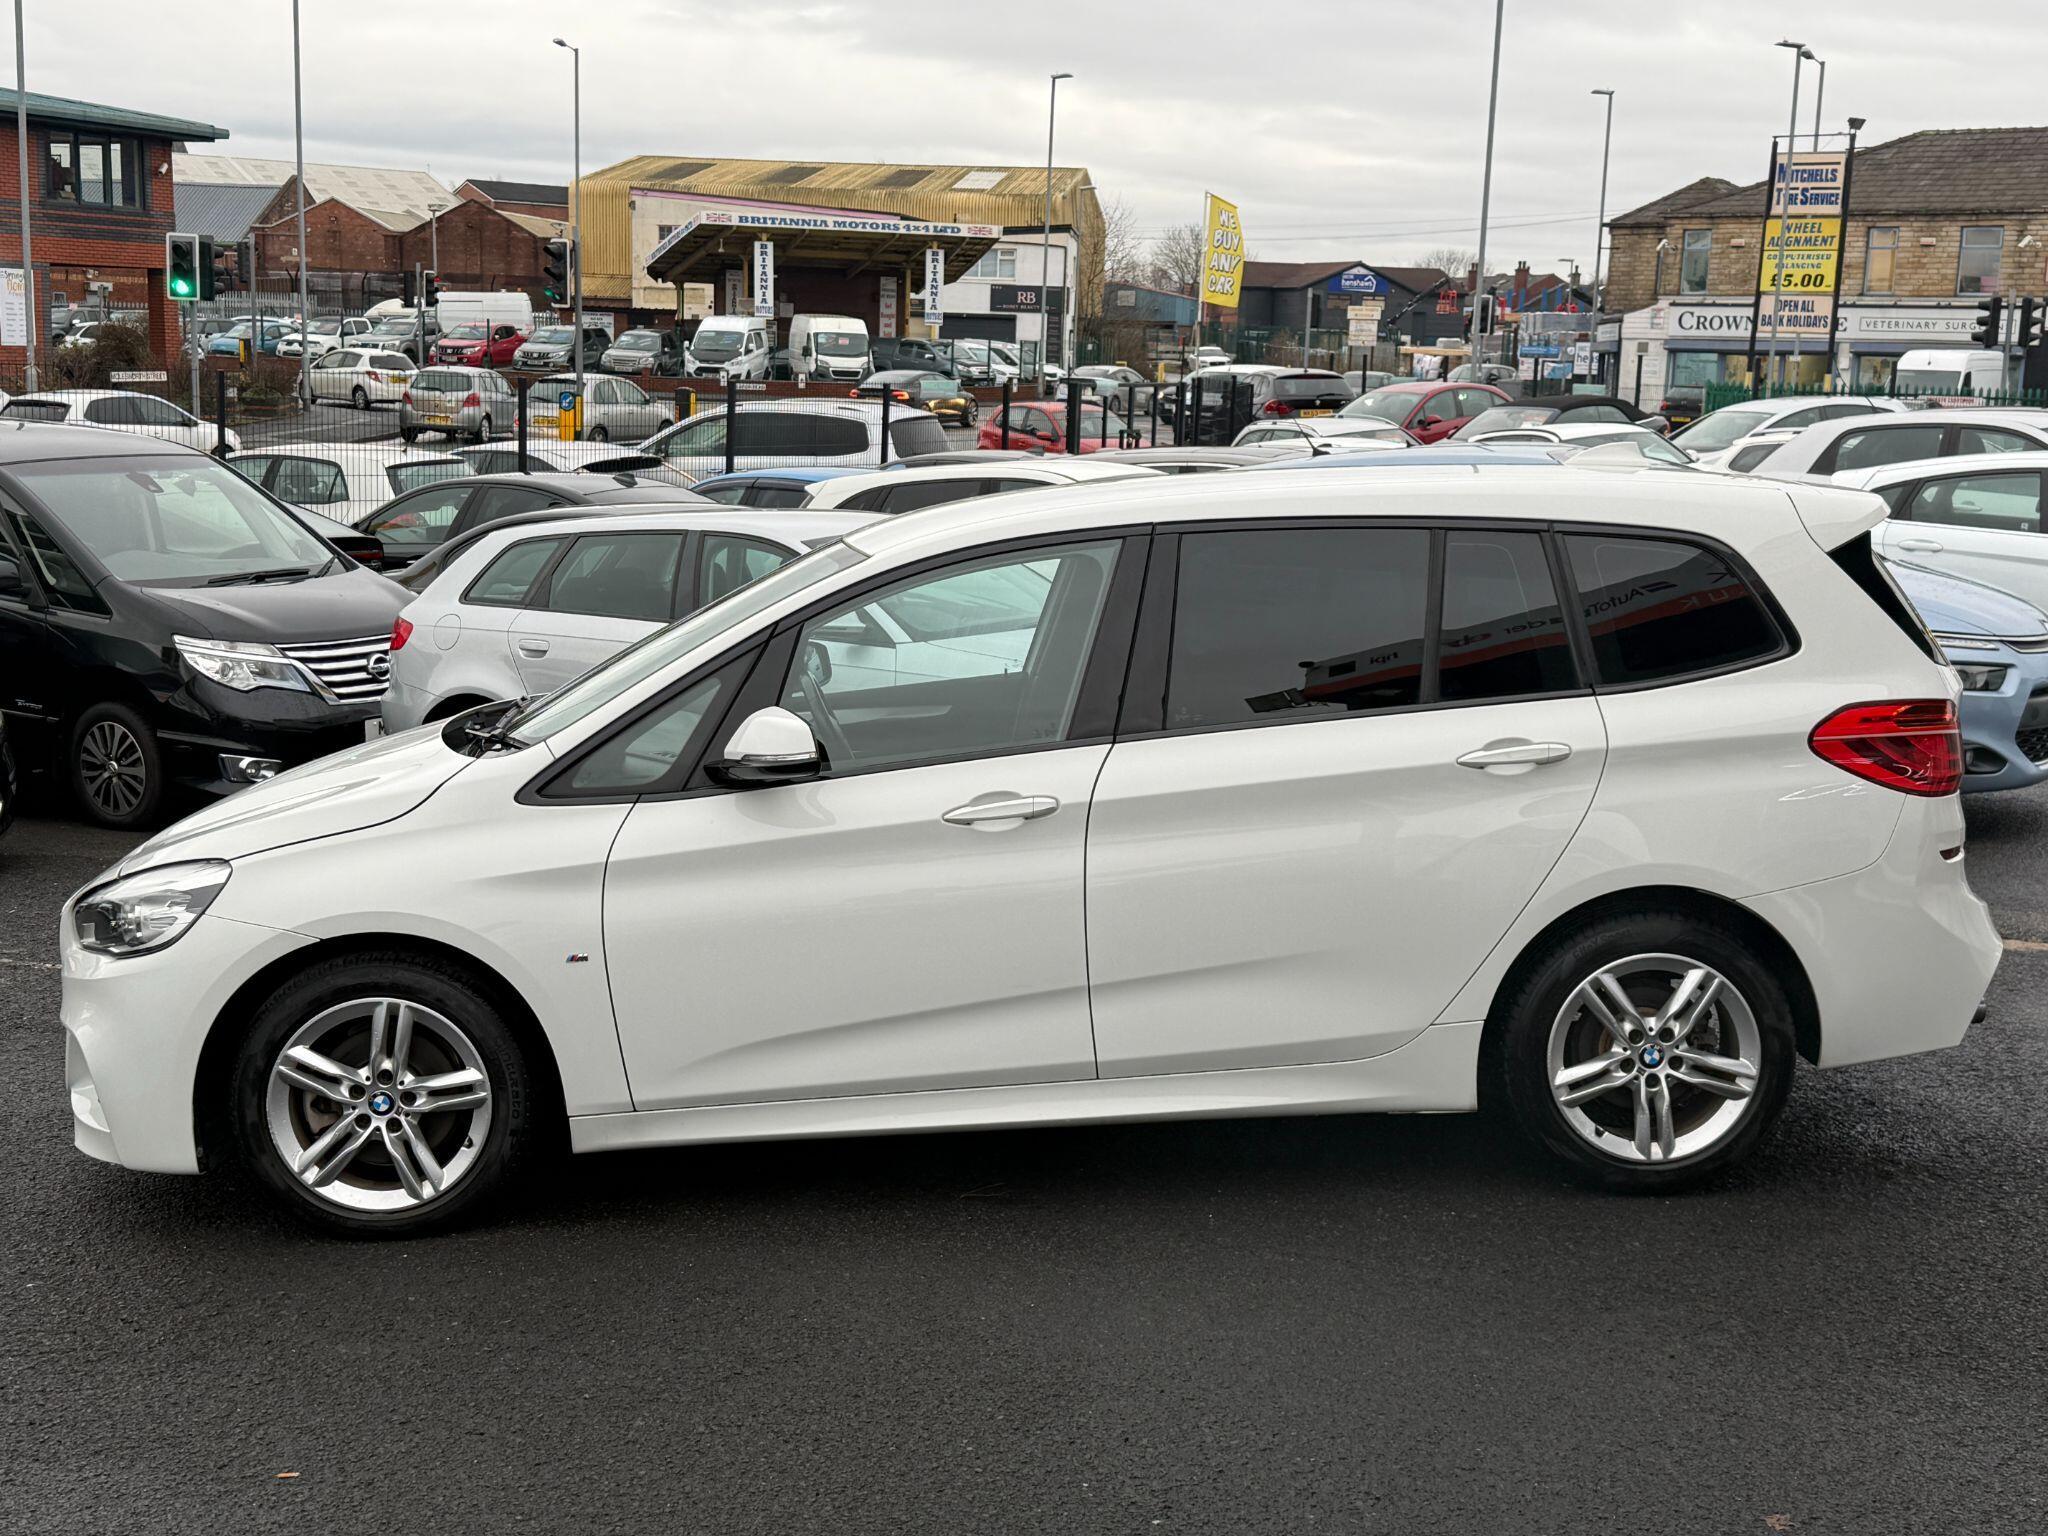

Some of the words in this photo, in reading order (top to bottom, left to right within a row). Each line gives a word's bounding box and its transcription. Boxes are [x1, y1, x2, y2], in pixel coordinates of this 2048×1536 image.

[1800, 187, 1840, 206] SERVICE
[738, 215, 829, 228] BRITANNIA
[832, 219, 900, 232] MOTORS
[902, 223, 930, 233] 4x4
[932, 225, 962, 234] LTD
[1220, 208, 1238, 230] WE
[1213, 229, 1241, 251] BUY
[1767, 235, 1836, 247] ALGNMENT
[1209, 251, 1241, 274] ANY
[1766, 253, 1832, 261] COPUTERISED
[759, 243, 769, 305] BRITANNIA
[929, 250, 940, 311] BRITANNIA
[1207, 273, 1235, 295] CAR
[1016, 291, 1036, 304] RB
[1800, 300, 1815, 313] ALL
[1760, 314, 1785, 328] BAK
[1785, 315, 1829, 329] HOLIDAYS
[1865, 320, 1938, 331] VETERINARY
